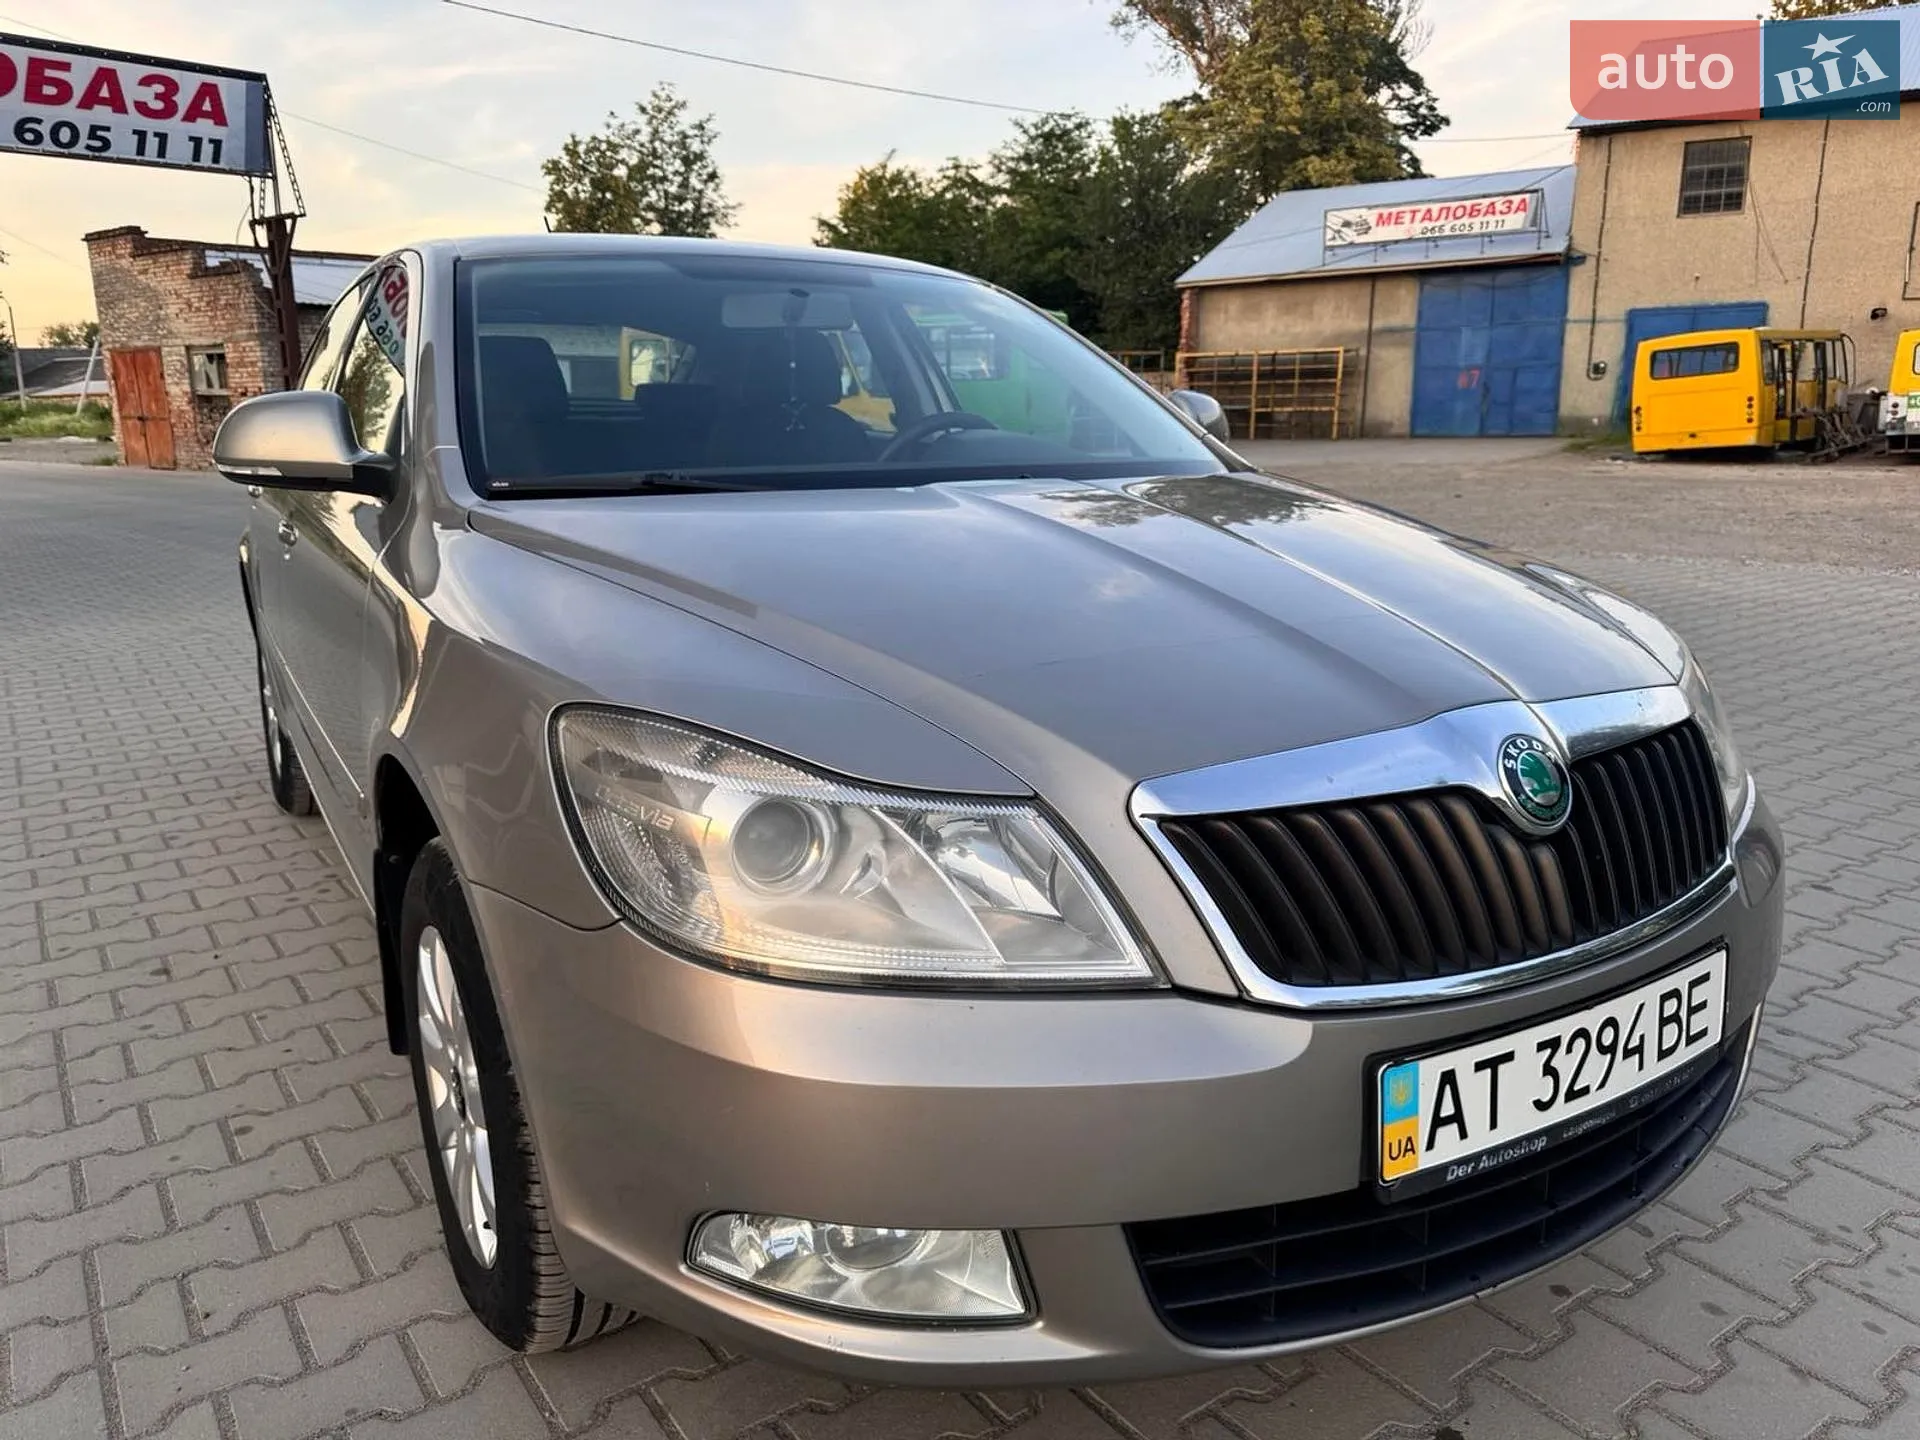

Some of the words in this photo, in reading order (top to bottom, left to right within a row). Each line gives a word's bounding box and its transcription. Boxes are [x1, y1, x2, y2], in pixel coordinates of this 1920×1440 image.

[13, 116, 112, 154] 605
[132, 128, 169, 159] 11
[188, 135, 223, 165] 11
[1375, 198, 1528, 227] МЕТАЛОБАЗА
[1449, 222, 1474, 235] 605
[1479, 220, 1490, 231] 11
[1495, 219, 1505, 229] 11
[1425, 1050, 1515, 1152] AT
[1531, 1002, 1645, 1112] 3294
[1656, 971, 1711, 1063] BE
[1388, 1136, 1416, 1161] UA
[1446, 1159, 1475, 1182] Der
